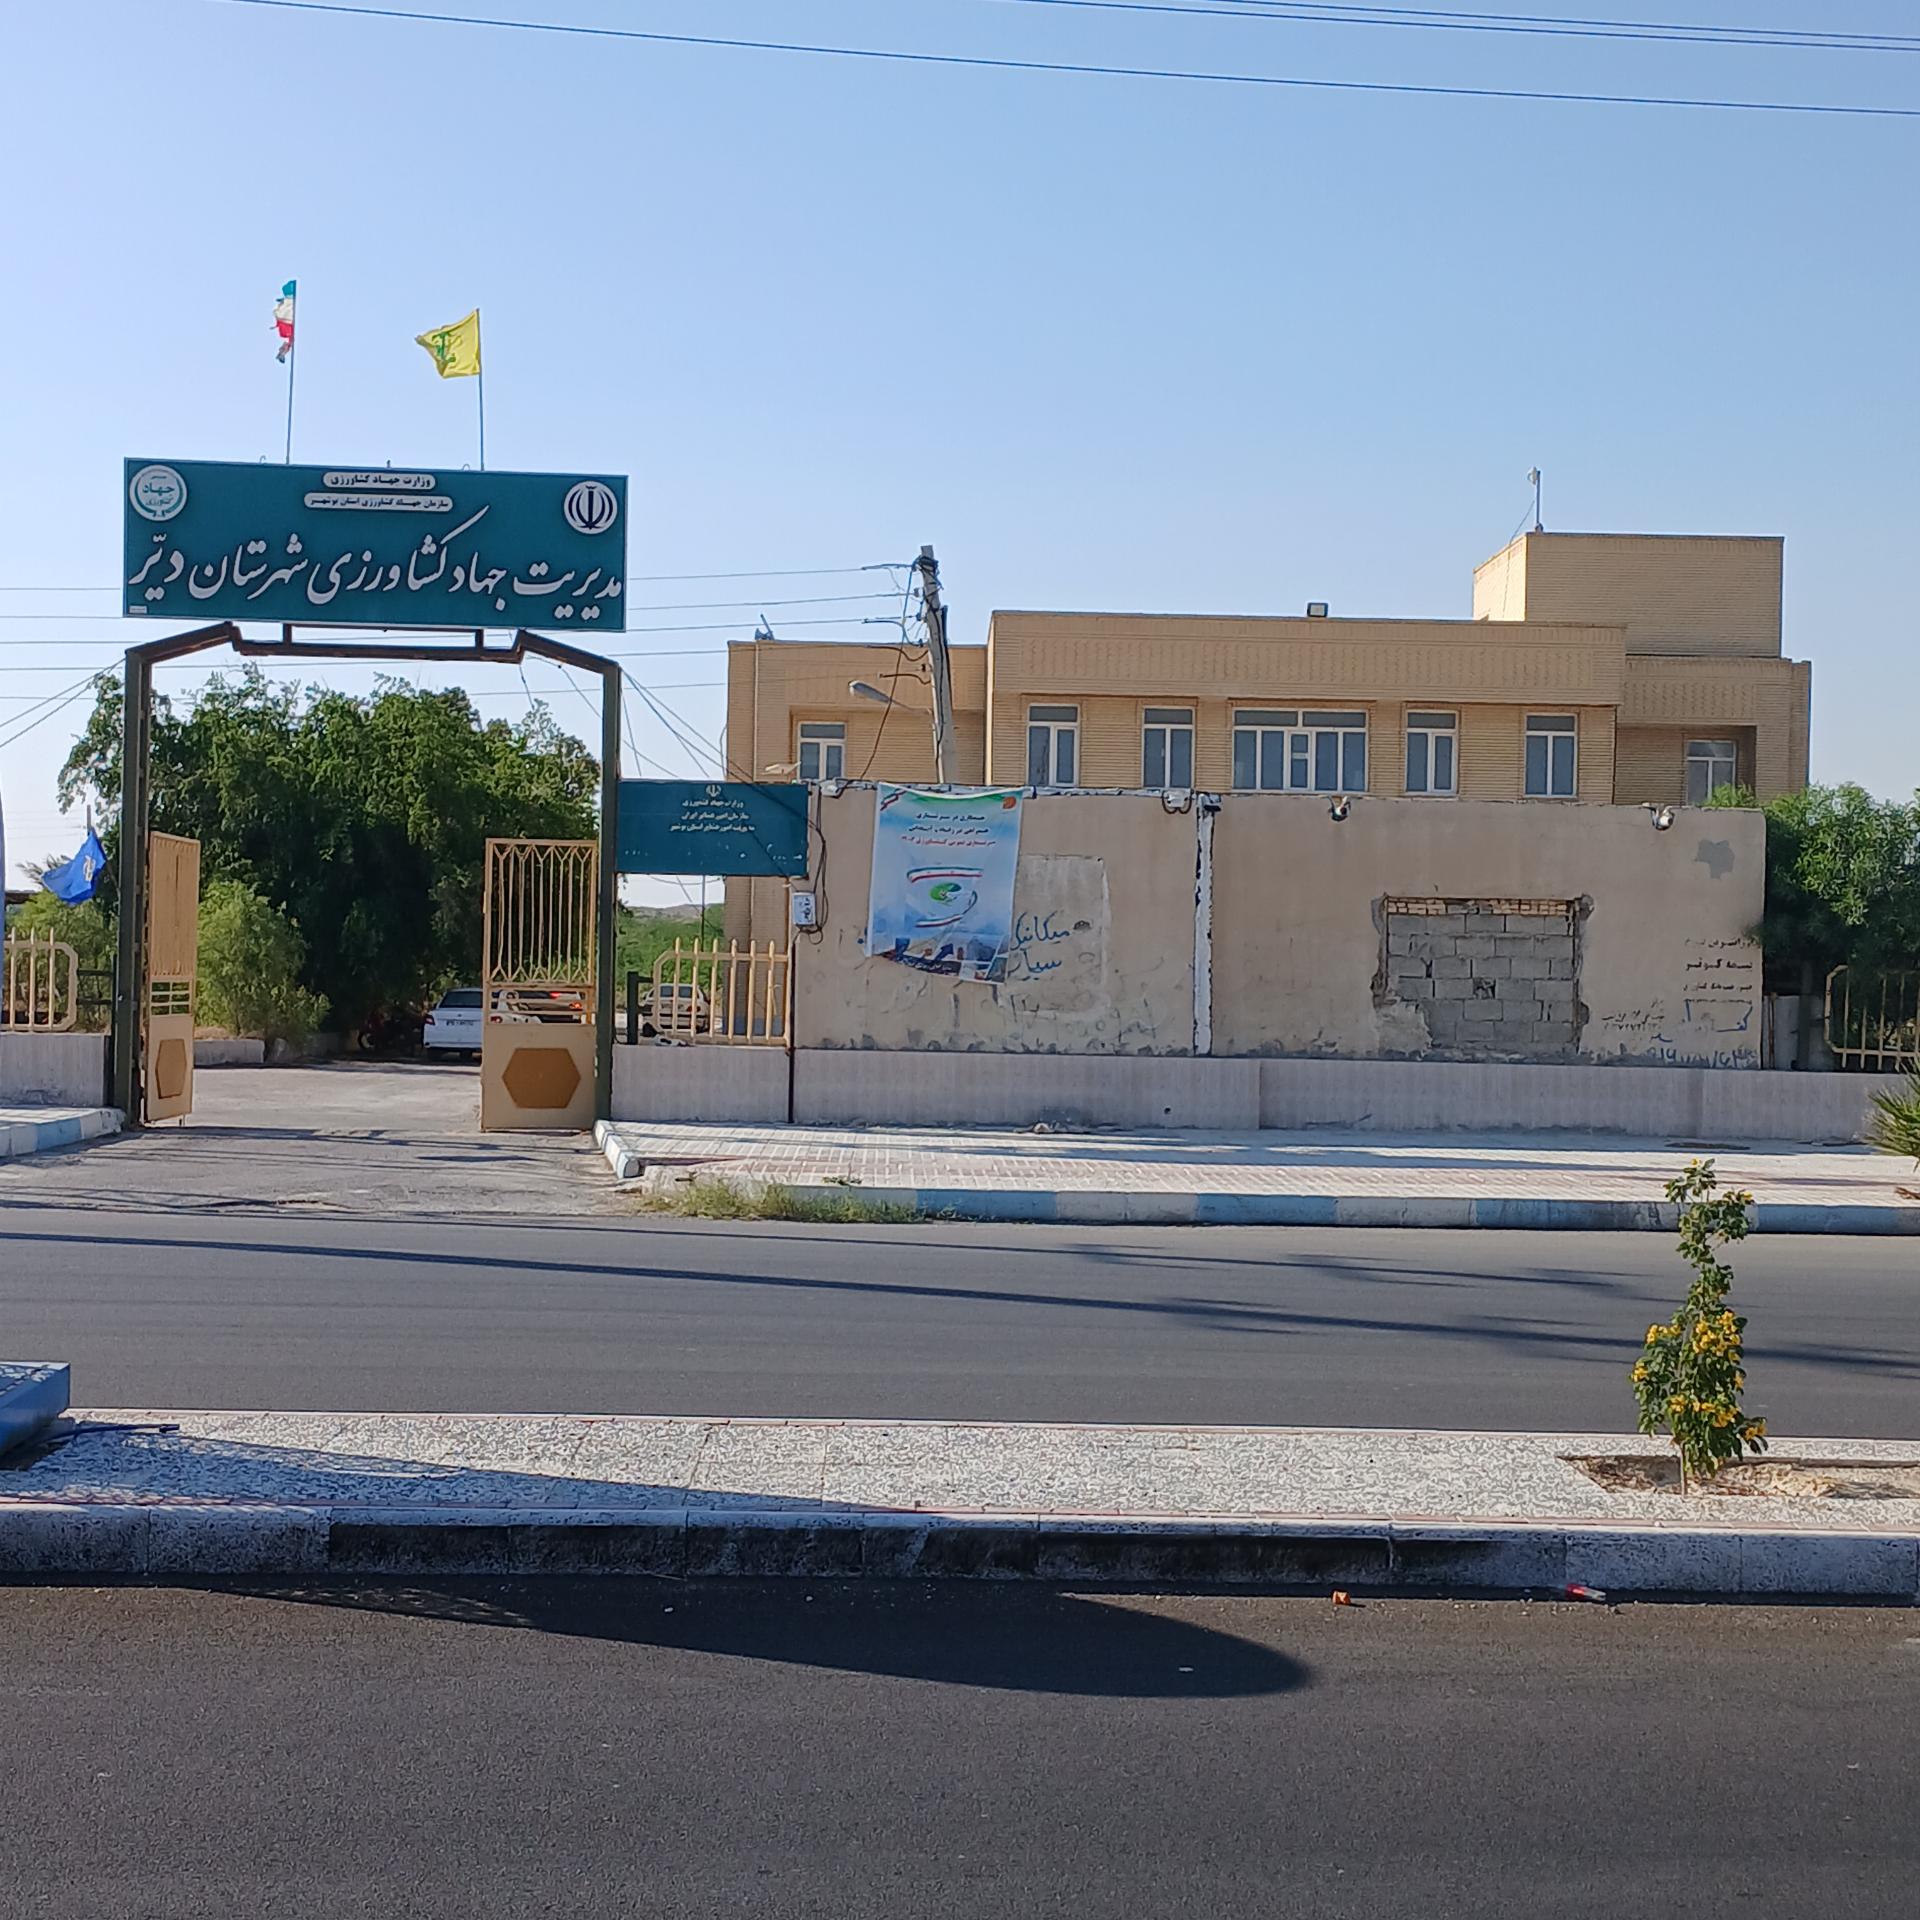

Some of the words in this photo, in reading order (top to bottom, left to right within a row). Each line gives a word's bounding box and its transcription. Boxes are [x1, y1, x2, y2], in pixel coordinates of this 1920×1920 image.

[330, 474, 371, 487] کشاورزی
[373, 473, 400, 486] جهاد
[402, 475, 432, 488] وزارت
[142, 482, 175, 496] جهاد
[310, 494, 337, 506] بوشهر
[340, 495, 361, 507] استان
[361, 496, 395, 508] کشاورزی
[395, 498, 422, 509] جهاد
[423, 498, 450, 510] سازمان
[306, 504, 489, 605] کشاورزی
[188, 532, 309, 600] شهرستان
[449, 551, 507, 611] جهاد
[513, 561, 622, 620] مدیریت
